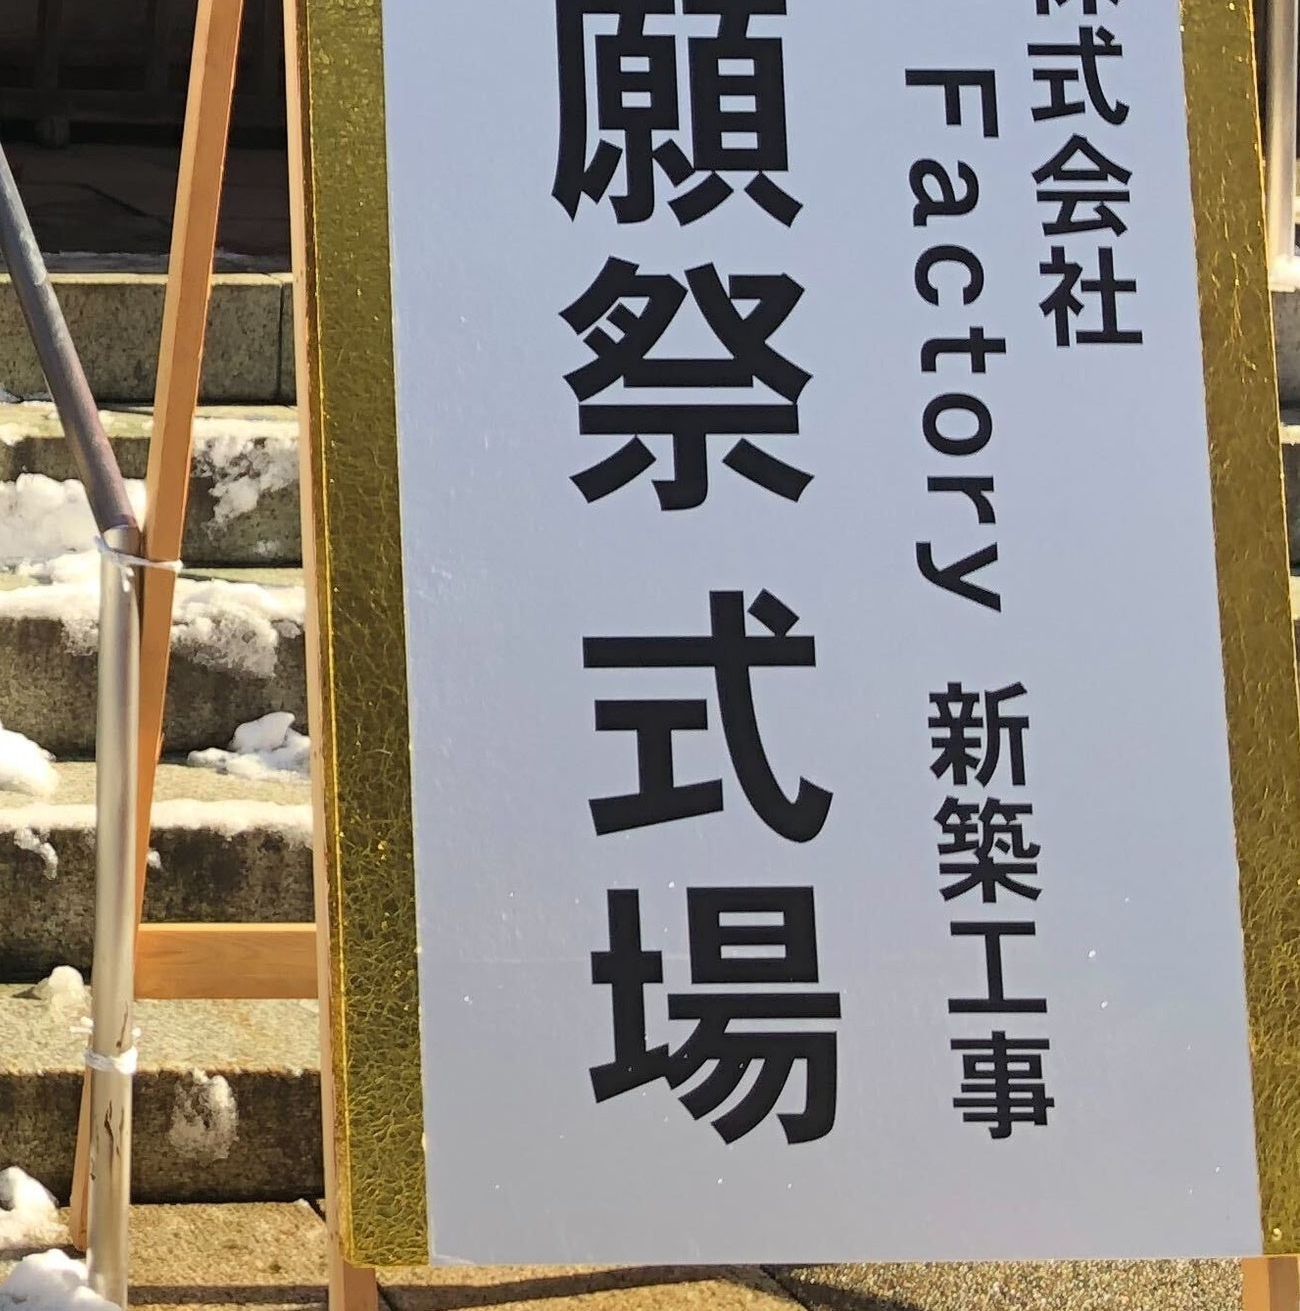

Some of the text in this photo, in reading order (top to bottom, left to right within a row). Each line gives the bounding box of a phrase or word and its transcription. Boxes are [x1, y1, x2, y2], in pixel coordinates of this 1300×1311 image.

[905, 68, 1006, 613] Factory
[927, 681, 1056, 1141] 新築工事
